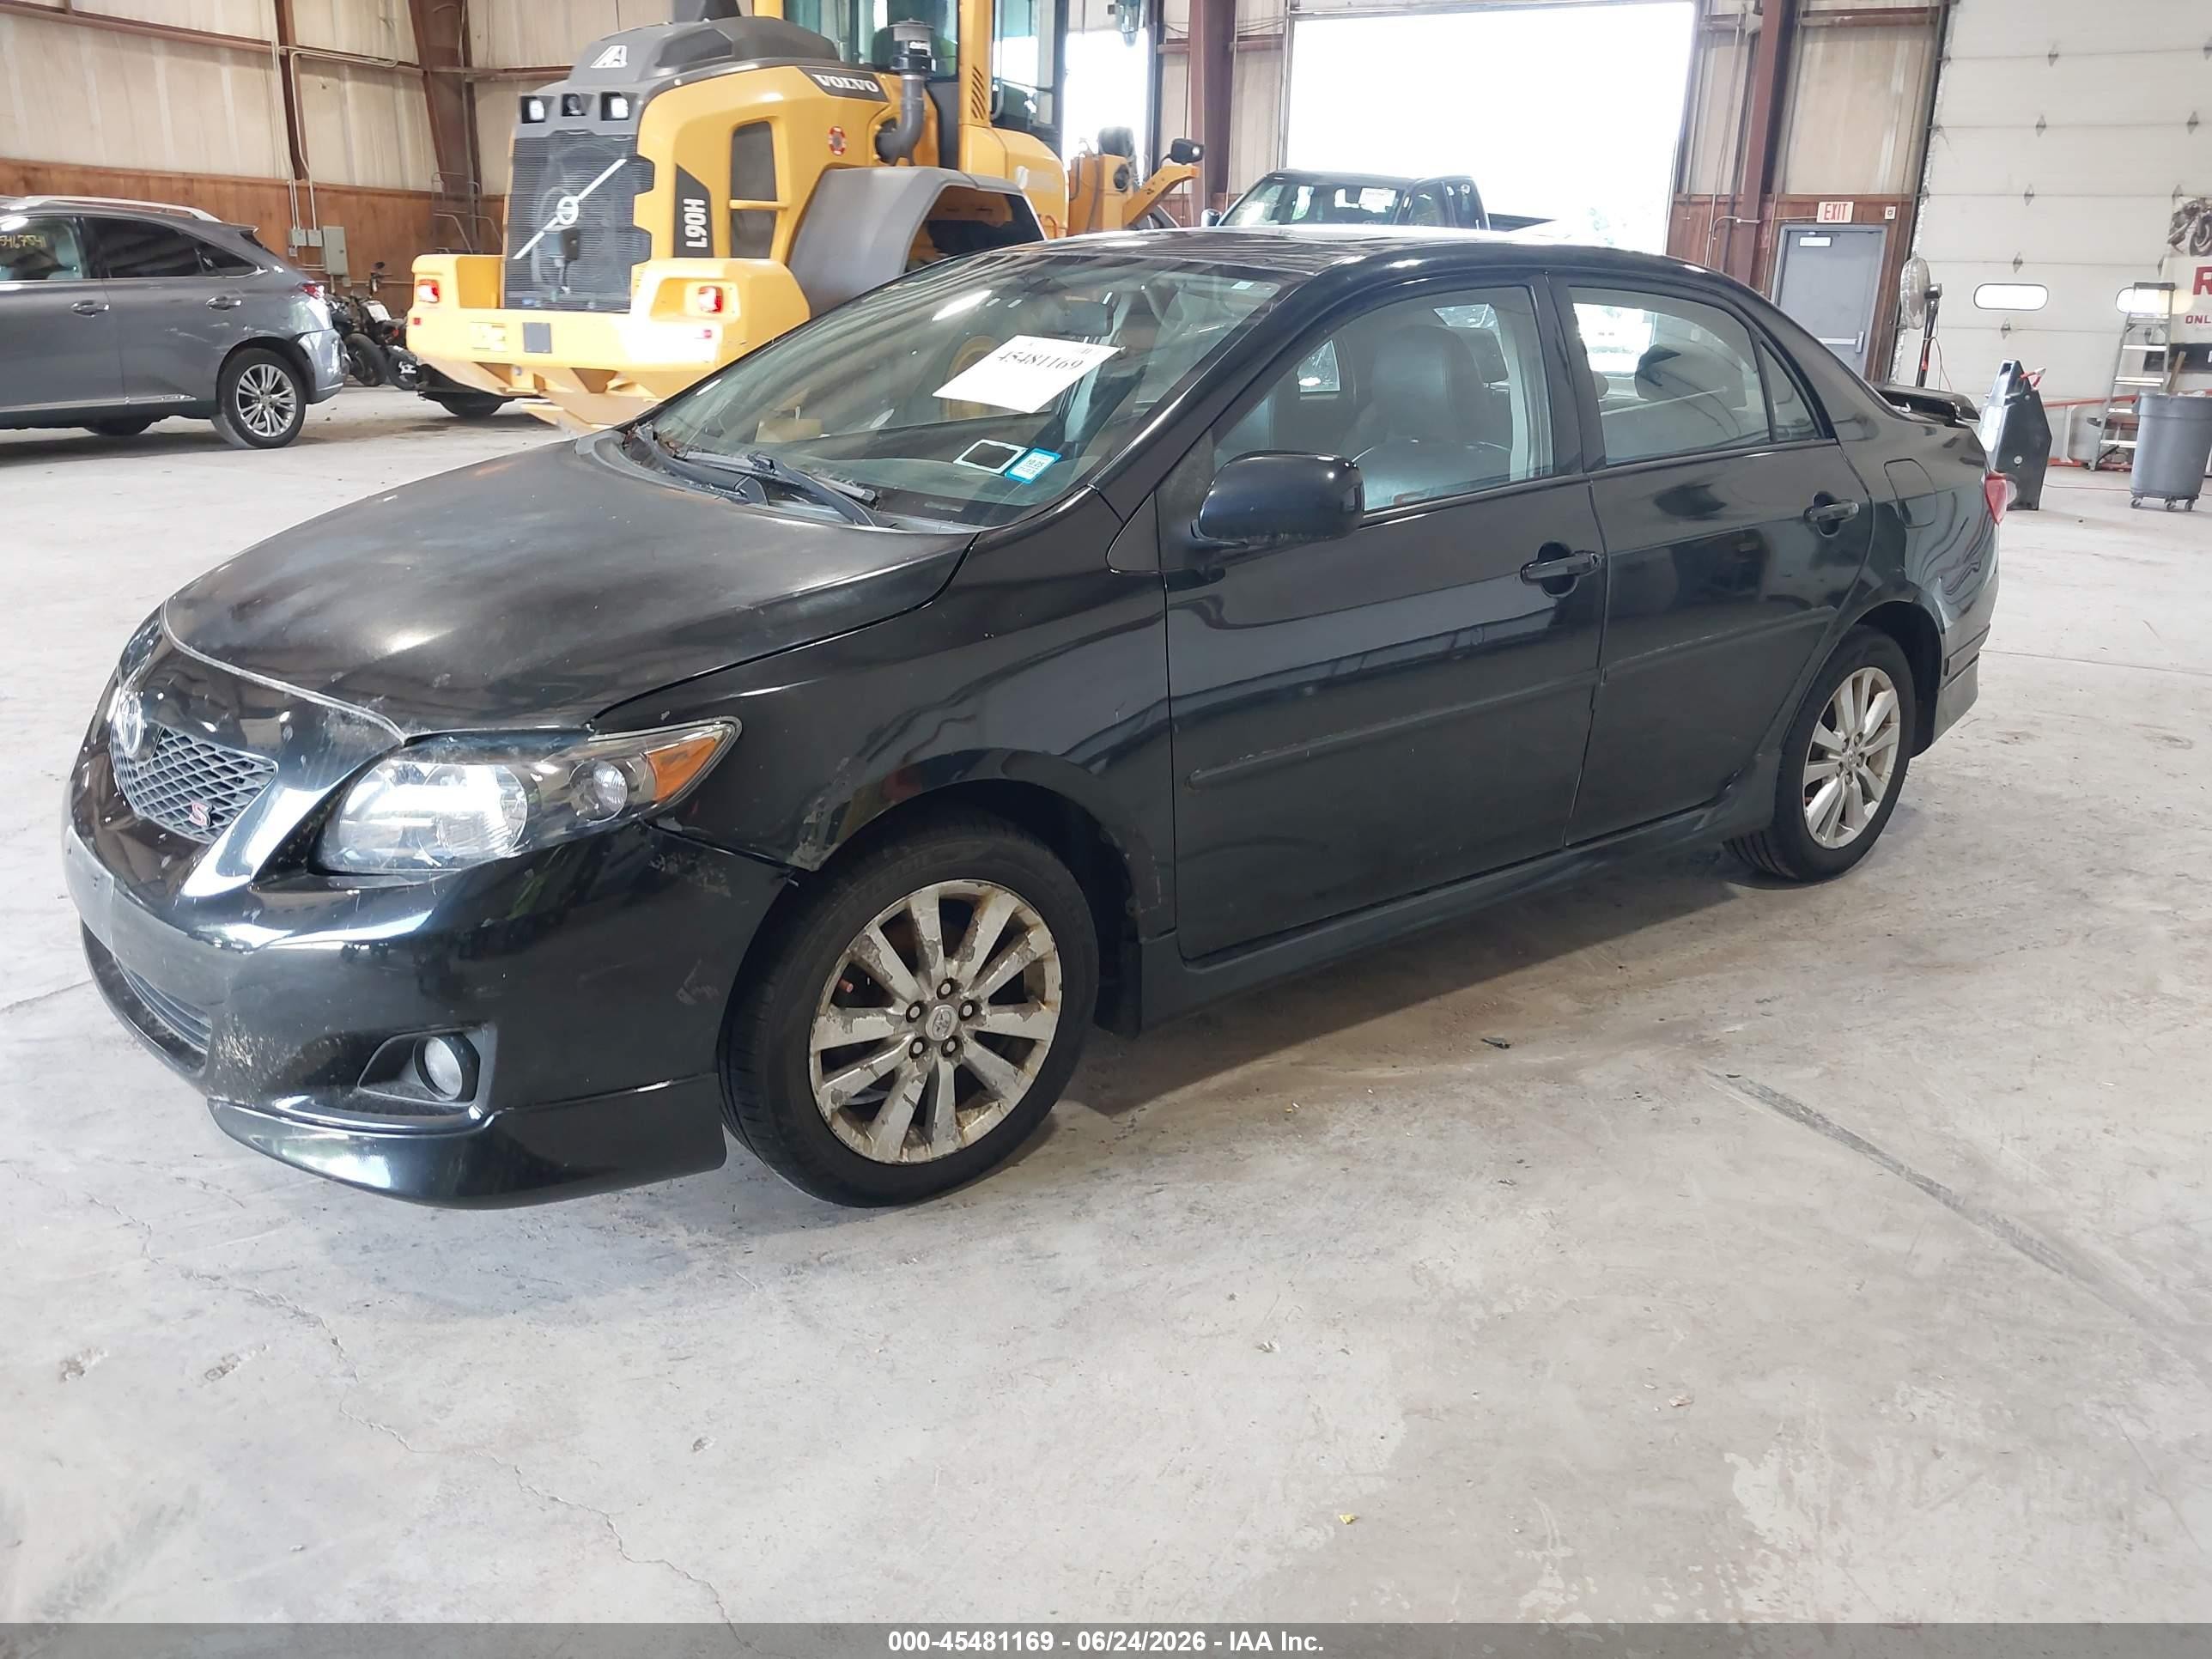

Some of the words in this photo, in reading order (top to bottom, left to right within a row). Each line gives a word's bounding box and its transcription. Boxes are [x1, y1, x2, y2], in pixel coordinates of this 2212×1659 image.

[811, 74, 879, 93] VOLVO
[1824, 203, 1848, 221] EXIT
[683, 198, 708, 247] L90H
[997, 349, 1085, 370] 45481169
